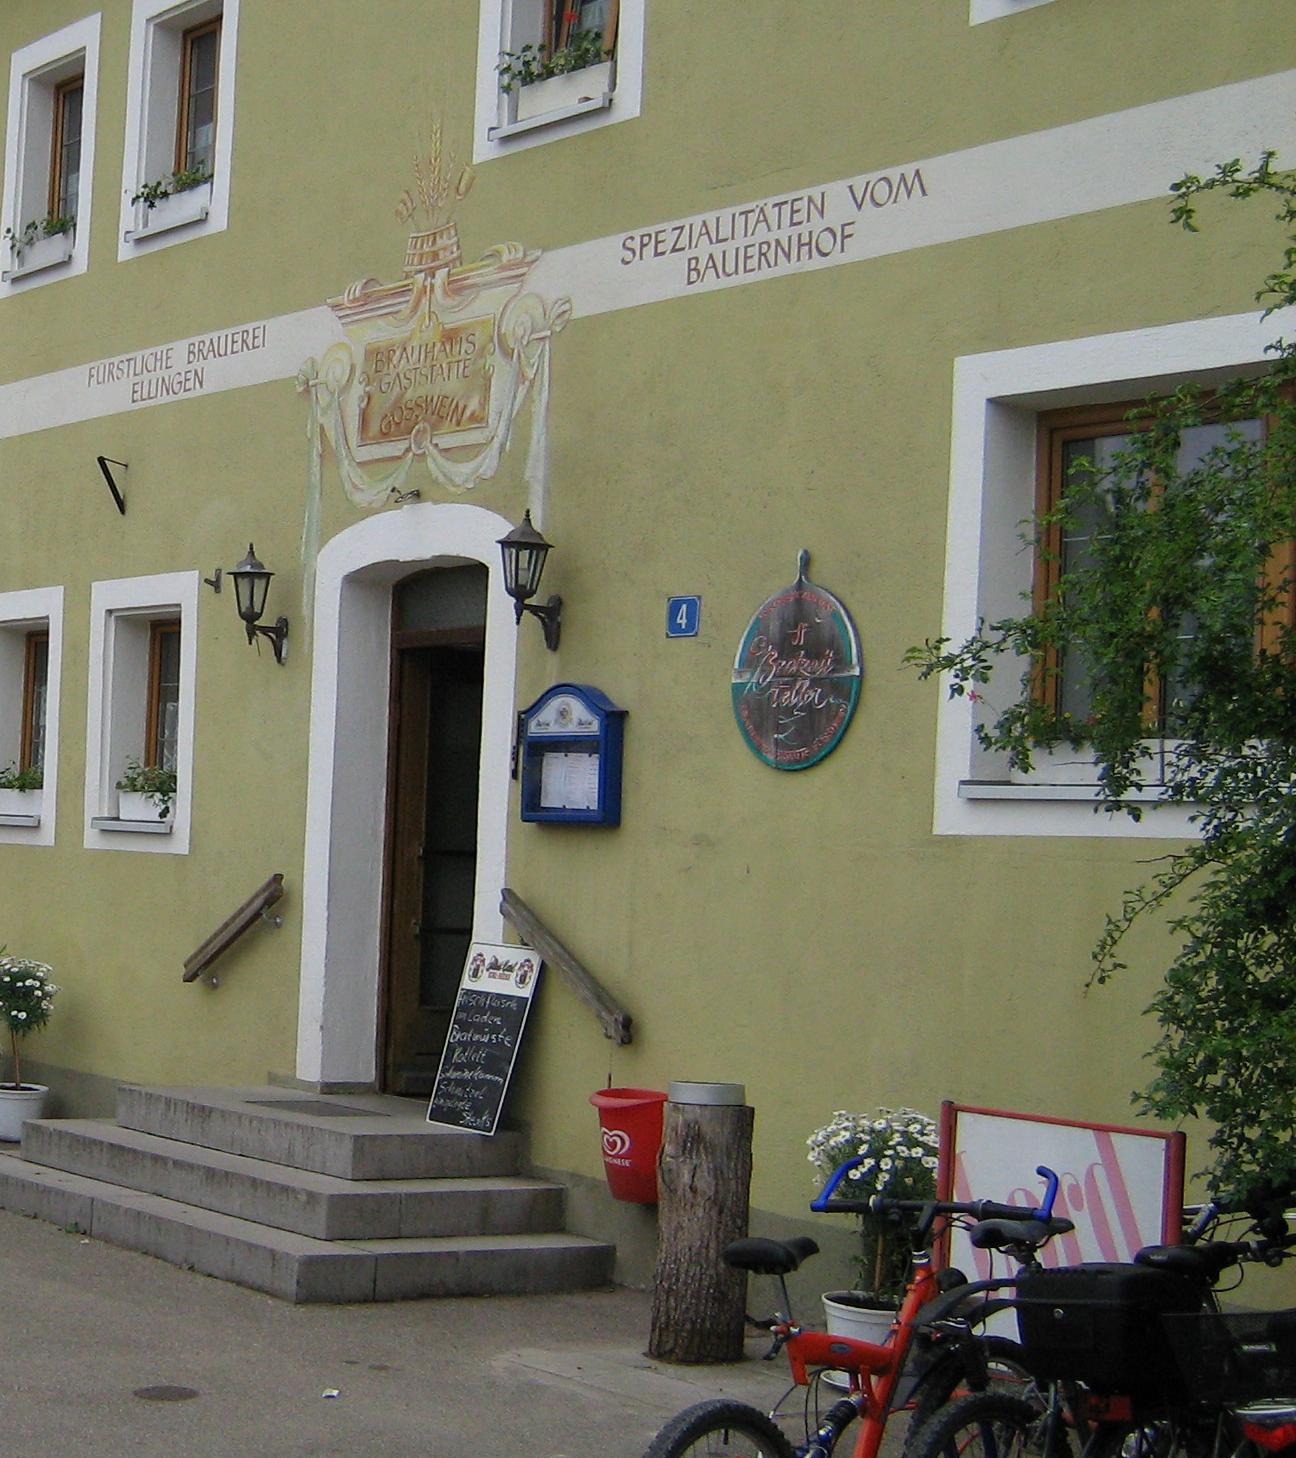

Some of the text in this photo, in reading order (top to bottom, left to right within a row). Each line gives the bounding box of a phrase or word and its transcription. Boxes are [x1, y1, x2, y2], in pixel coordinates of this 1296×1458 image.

[620, 168, 929, 266] SPEZIALITÄTEN VOM
[686, 221, 856, 286] BAUERNHOF
[186, 325, 267, 365] BRAUEREI
[374, 332, 477, 373] BRAUHAUS
[130, 367, 206, 404] ELLINGEN
[676, 603, 688, 629] 4
